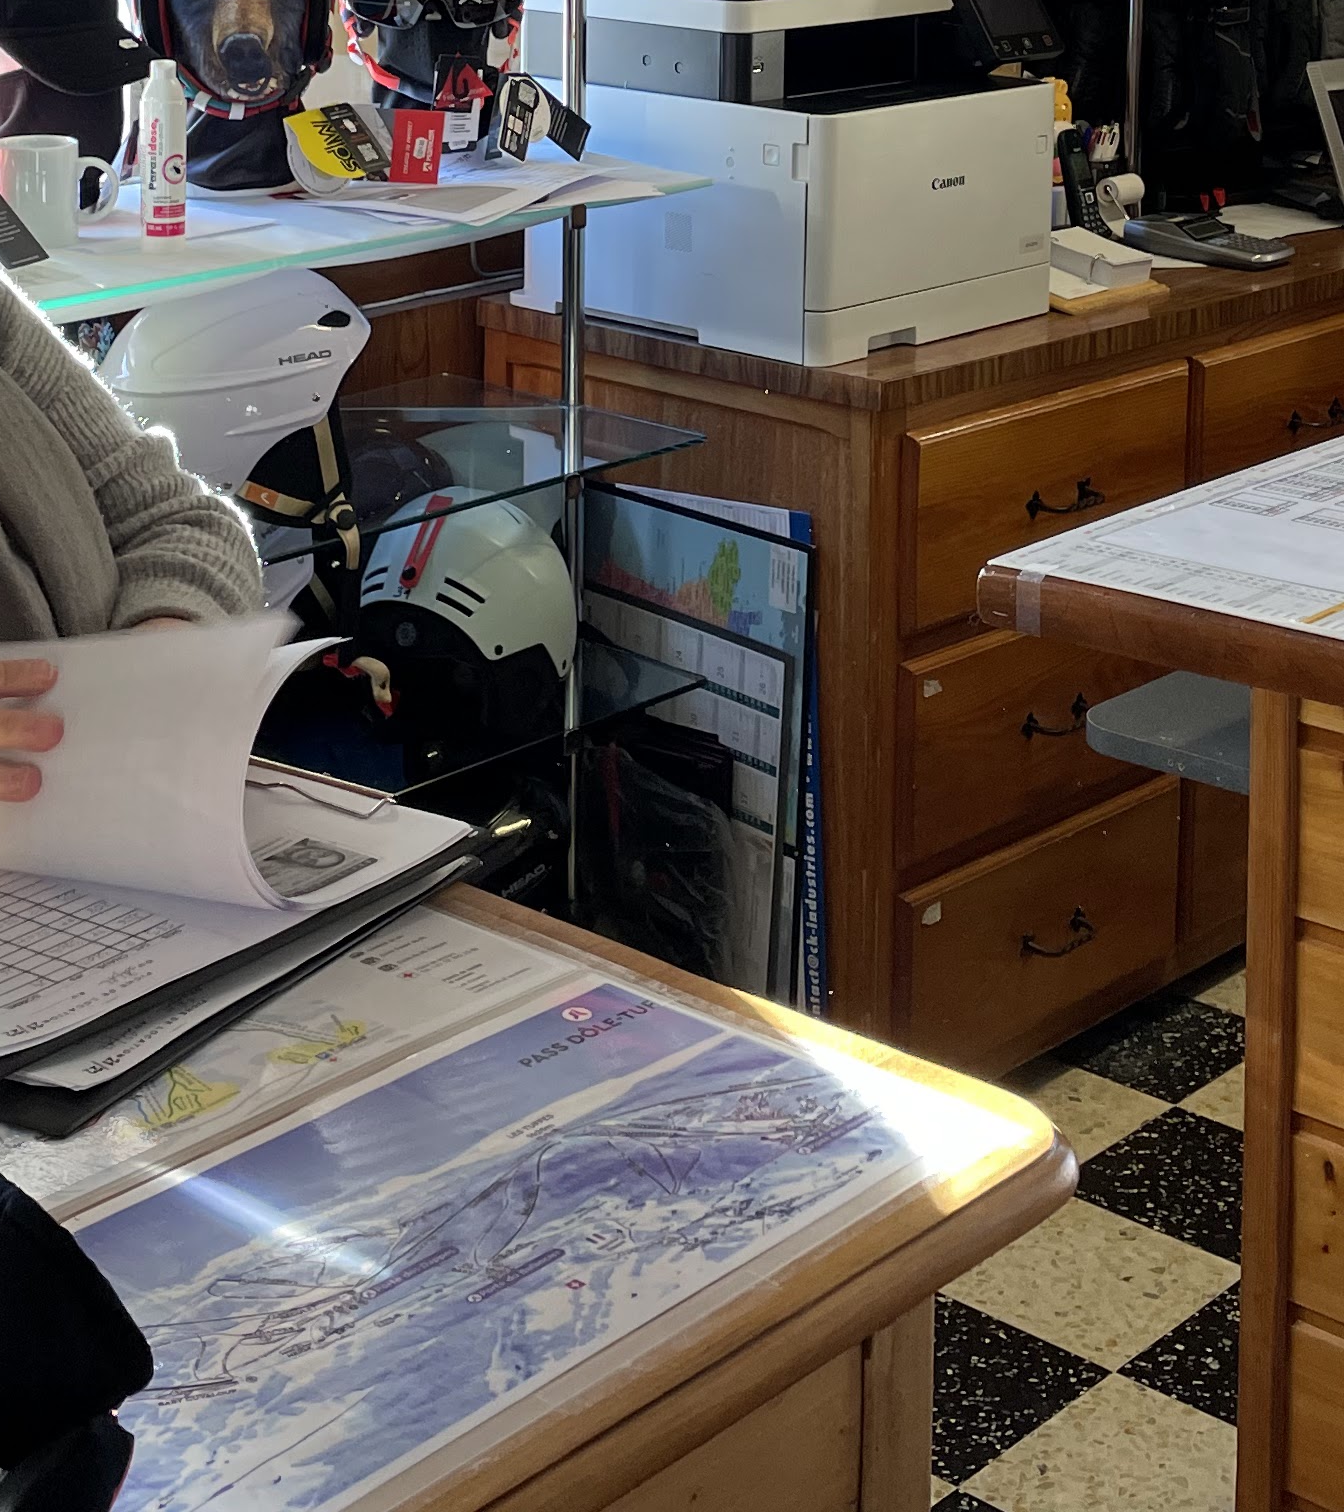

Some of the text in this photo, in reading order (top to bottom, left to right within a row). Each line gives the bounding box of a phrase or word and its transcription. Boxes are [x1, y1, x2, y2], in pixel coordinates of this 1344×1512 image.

[931, 175, 966, 191] Canon
[278, 348, 333, 367] HEAD
[518, 1042, 569, 1068] PASS
